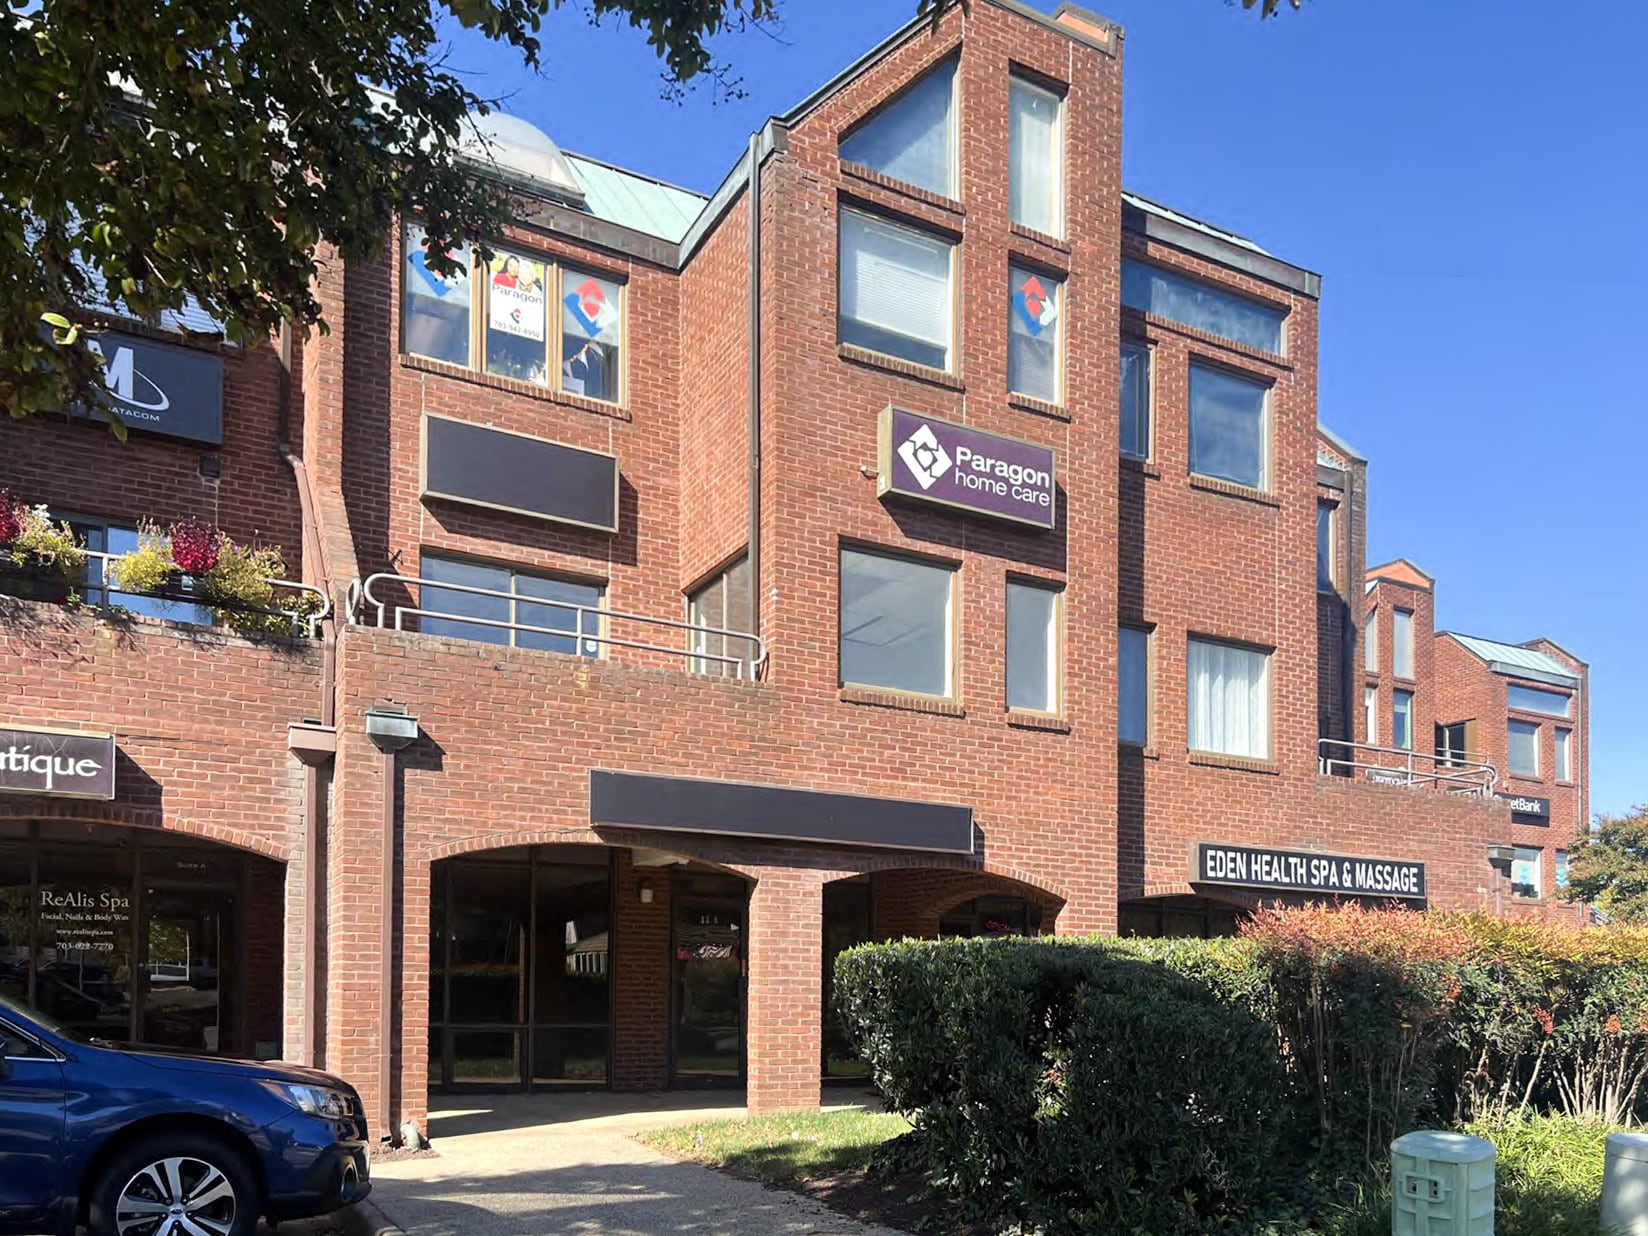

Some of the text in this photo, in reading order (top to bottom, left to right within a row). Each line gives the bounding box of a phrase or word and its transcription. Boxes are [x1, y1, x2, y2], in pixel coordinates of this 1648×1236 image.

[492, 284, 542, 304] Paragon
[956, 446, 1050, 488] Paragon
[955, 467, 1050, 506] home care
[1206, 850, 1418, 893] EDEN HEALTH SPA & MASSAGE
[41, 891, 130, 911] ReAlis Spa
[66, 913, 84, 921] Nails
[94, 914, 111, 922] Body
